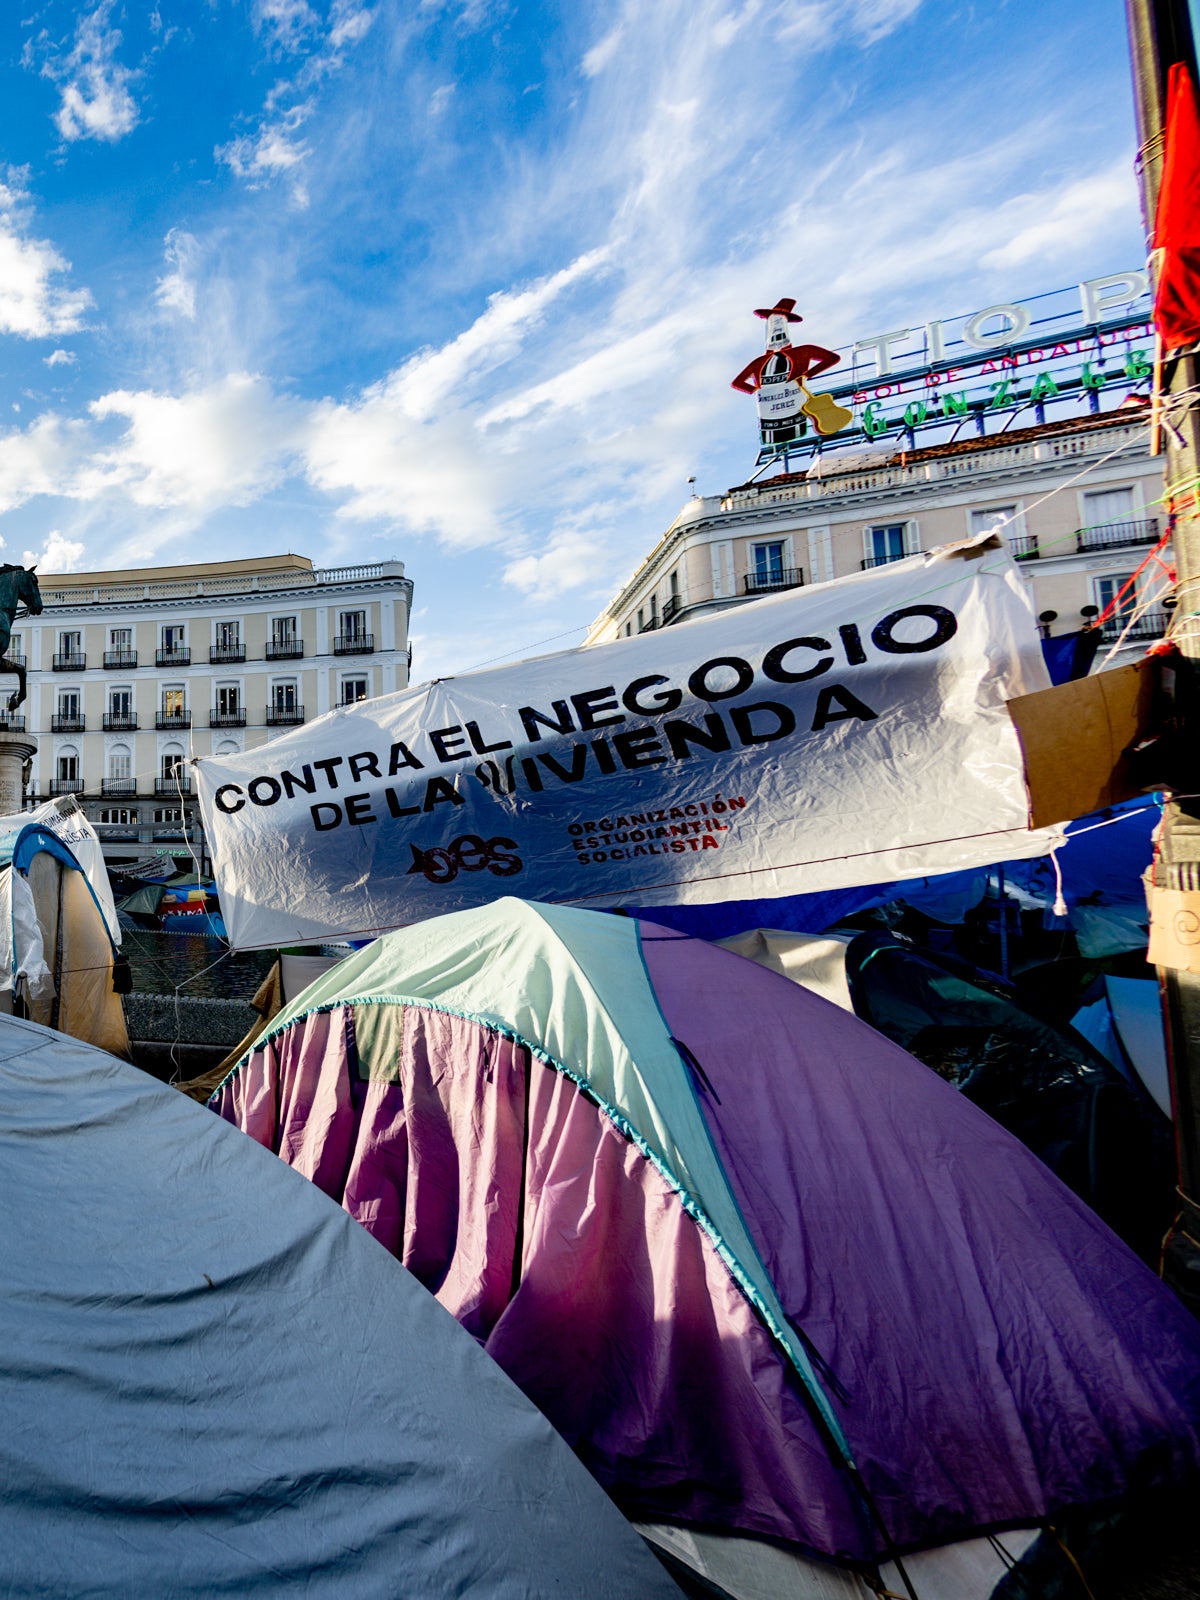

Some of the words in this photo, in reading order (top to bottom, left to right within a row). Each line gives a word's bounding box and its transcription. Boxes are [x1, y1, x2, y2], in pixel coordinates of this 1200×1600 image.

[853, 382, 914, 404] SOL
[925, 366, 964, 386] DE
[980, 321, 1158, 375] ANDALUCI
[854, 304, 1031, 377] TIO
[770, 399, 795, 411] JEREZ
[862, 349, 1152, 435] GONZALE
[214, 741, 425, 814] CONTRA
[428, 720, 513, 763] EL
[518, 604, 958, 743] NEGOCIO
[310, 792, 377, 831] DE
[385, 775, 466, 818] LA
[475, 684, 879, 796] VIVIENDA
[567, 793, 746, 837] ORGANIZACIÓN
[571, 818, 729, 852] ESTUDIANTIL
[578, 835, 720, 866] SOCIALISTA
